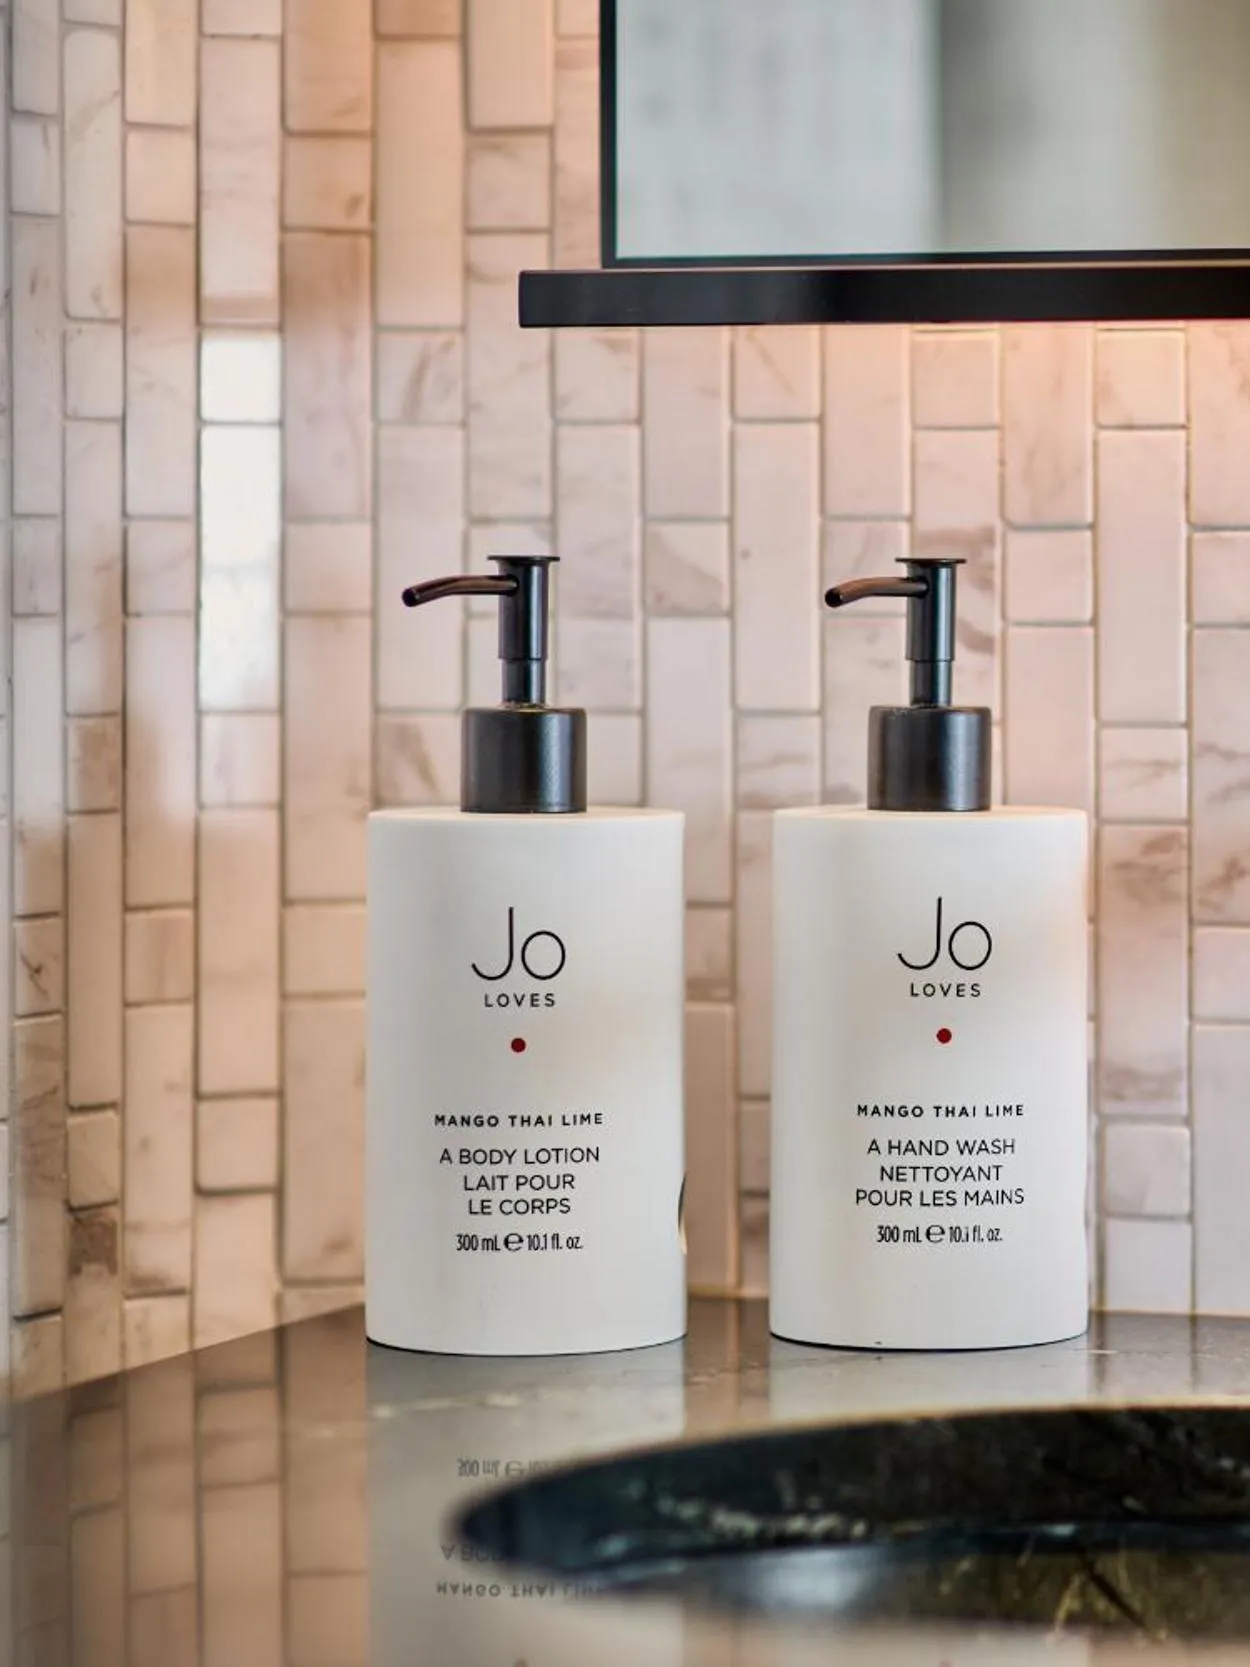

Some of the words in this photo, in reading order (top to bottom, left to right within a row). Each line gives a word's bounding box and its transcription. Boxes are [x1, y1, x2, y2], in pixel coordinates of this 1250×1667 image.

[910, 982, 981, 998] LOVES
[484, 992, 556, 1008] LOVES
[434, 1114, 500, 1128] MANGO
[507, 1114, 553, 1128] THAI
[561, 1112, 603, 1127] LIME
[857, 1104, 924, 1118] MANGO
[932, 1105, 976, 1118] THAI
[985, 1104, 1024, 1118] LIME
[439, 1148, 453, 1165] A
[458, 1148, 518, 1166] BODY
[524, 1146, 600, 1165] LOTION
[867, 1138, 881, 1155] A
[887, 1139, 950, 1156] HAND
[955, 1138, 1015, 1156] WASH
[463, 1174, 509, 1192] LAIT
[515, 1173, 575, 1192] POUR
[879, 1164, 1003, 1183] NETTOYANT
[855, 1188, 913, 1207] POUR
[919, 1190, 958, 1207] LES
[964, 1187, 1025, 1207] MAINS
[468, 1199, 493, 1216] LE
[498, 1197, 571, 1216] CORPS
[456, 1233, 479, 1252] 300
[526, 1233, 548, 1252] 10.1
[876, 1225, 900, 1243] 300
